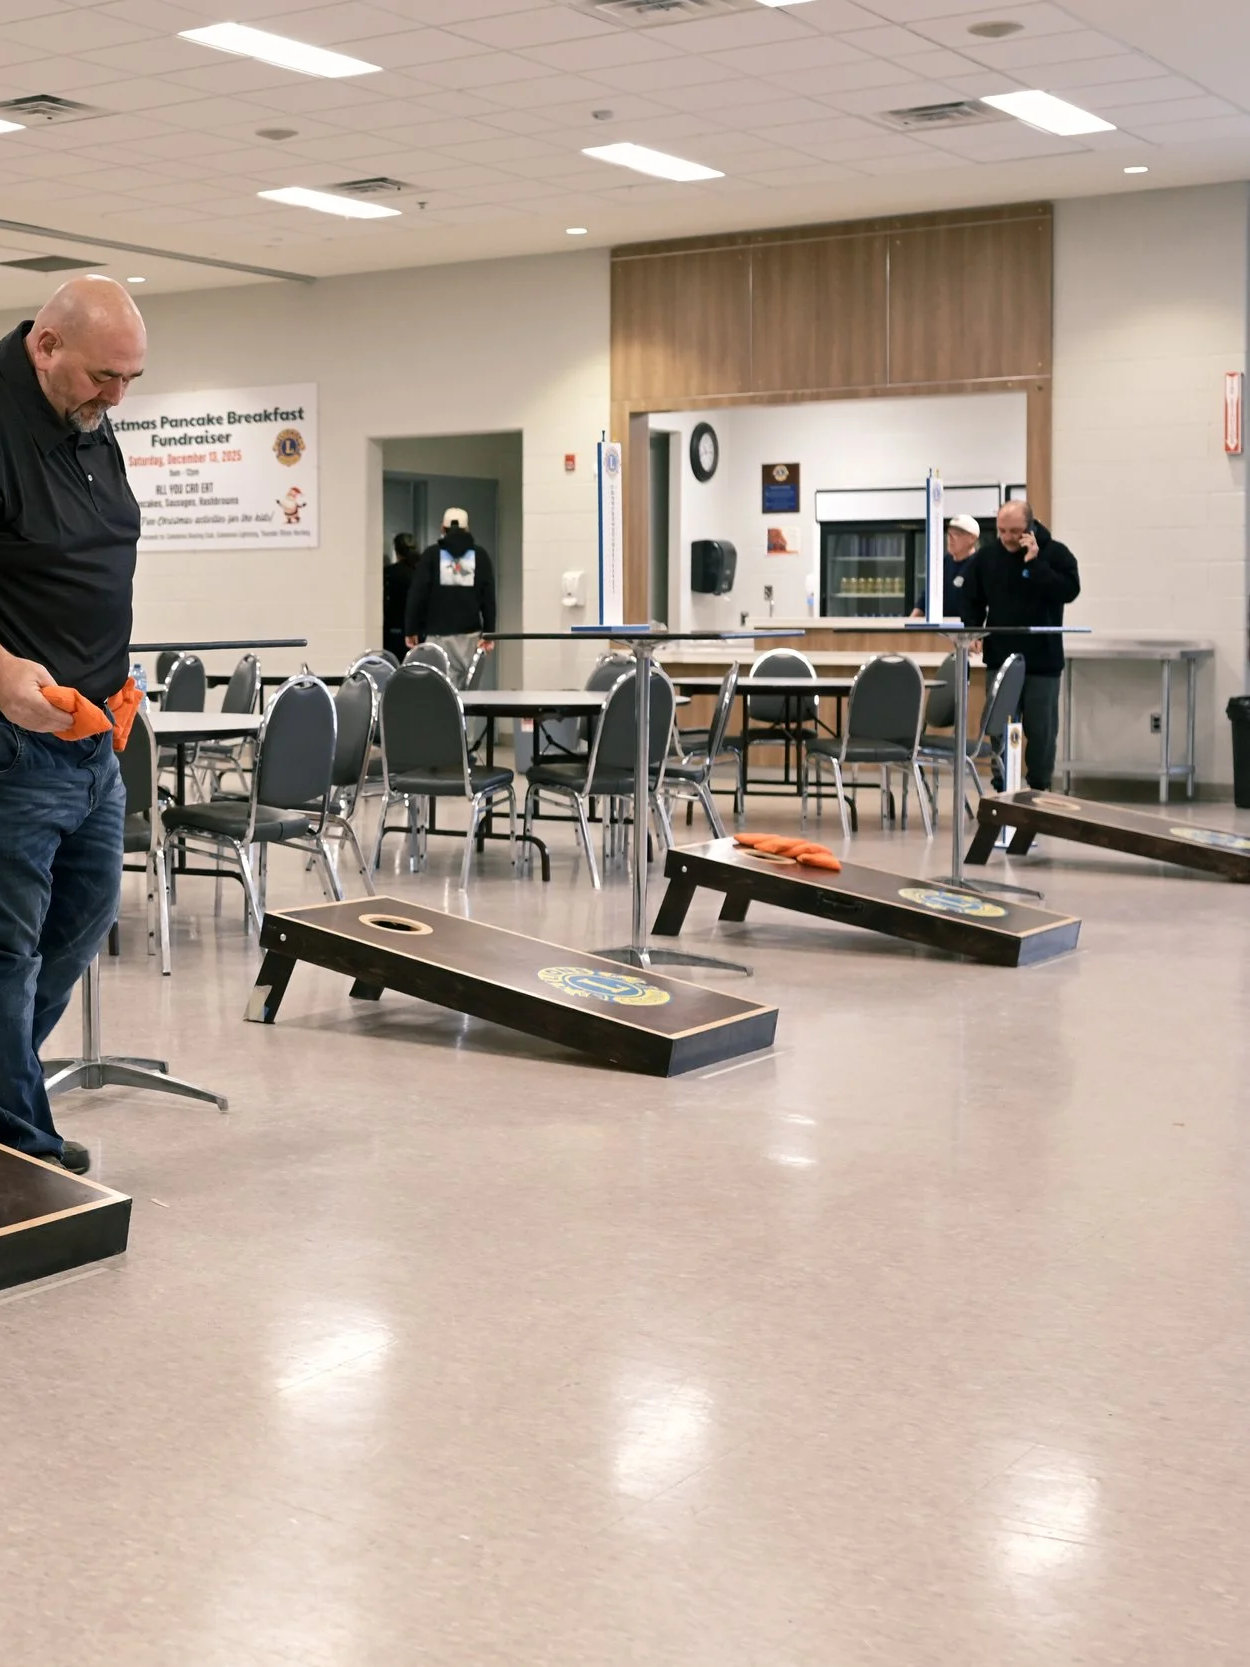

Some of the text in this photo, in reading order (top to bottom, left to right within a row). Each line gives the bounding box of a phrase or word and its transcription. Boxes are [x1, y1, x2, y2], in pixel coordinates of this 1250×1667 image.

[160, 413, 224, 428] Pancake
[227, 407, 304, 425] Breakfast
[151, 430, 232, 448] Fundraiser
[129, 456, 165, 467] Saturday,
[167, 453, 206, 465] December
[222, 450, 242, 462] 2025
[156, 482, 213, 495] ALL YOU CAN EAT
[577, 978, 630, 994] L
